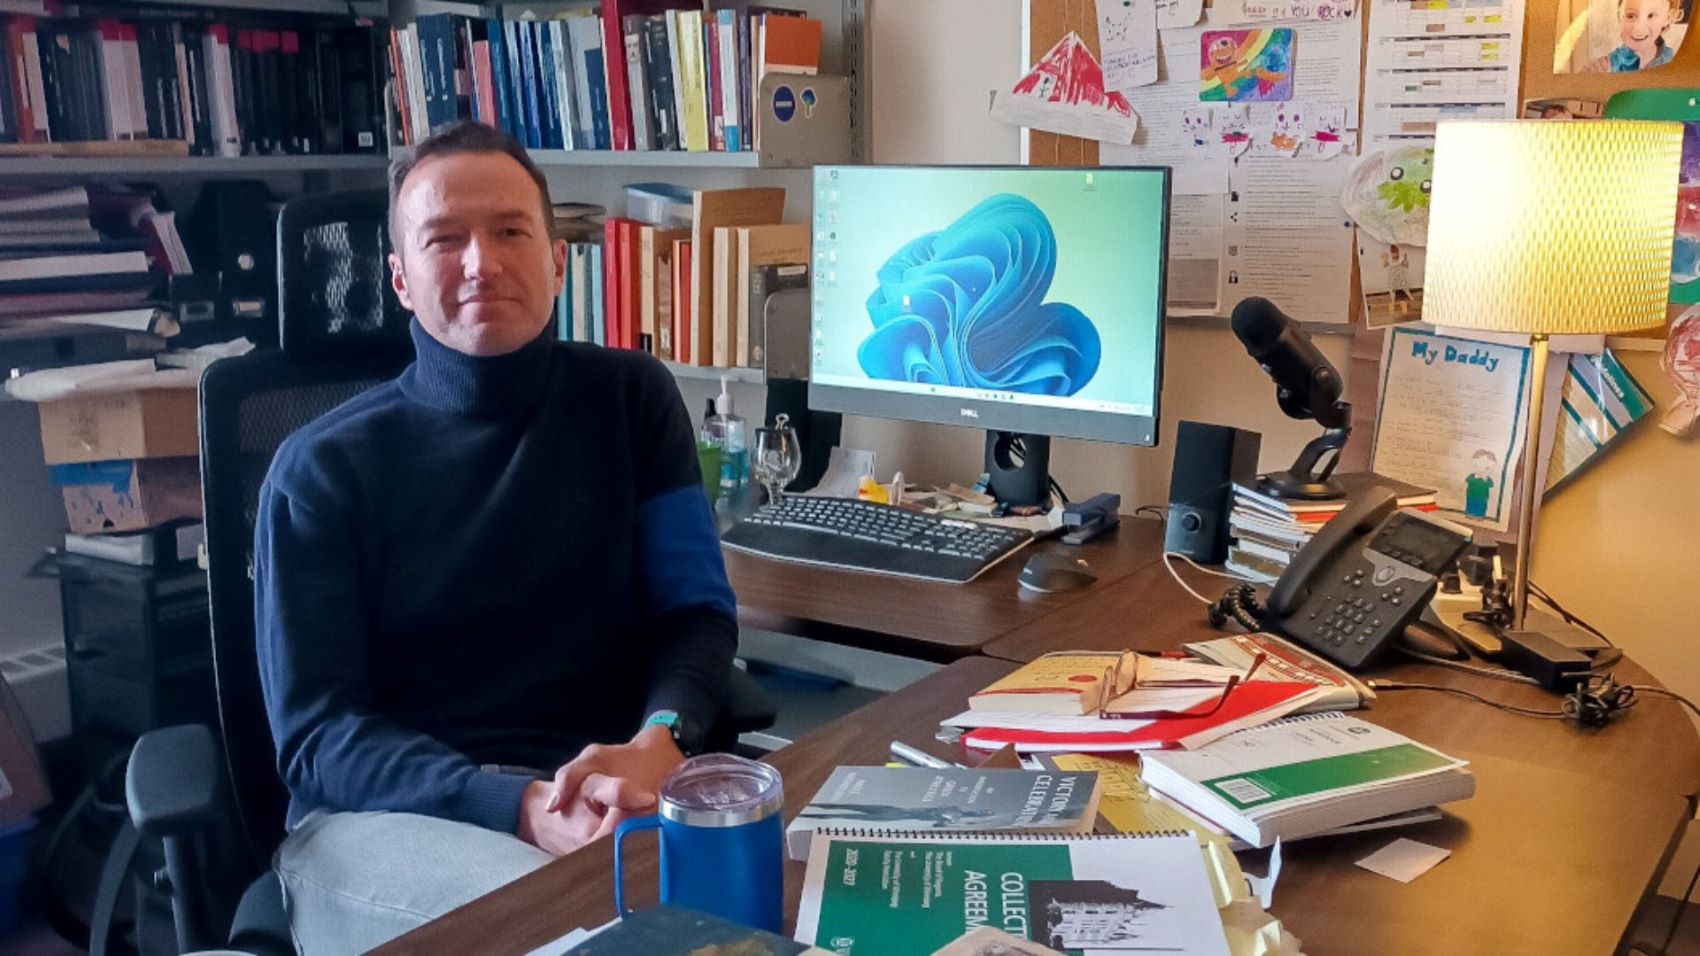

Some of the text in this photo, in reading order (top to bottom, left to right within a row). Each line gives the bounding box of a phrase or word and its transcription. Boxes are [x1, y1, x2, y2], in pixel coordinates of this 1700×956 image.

[1411, 341, 1500, 373] My Daddy
[960, 407, 979, 418] DELL
[1047, 776, 1077, 812] VICTORY
[964, 869, 989, 935] AGREEM
[1001, 872, 1028, 940] COLLECTI
